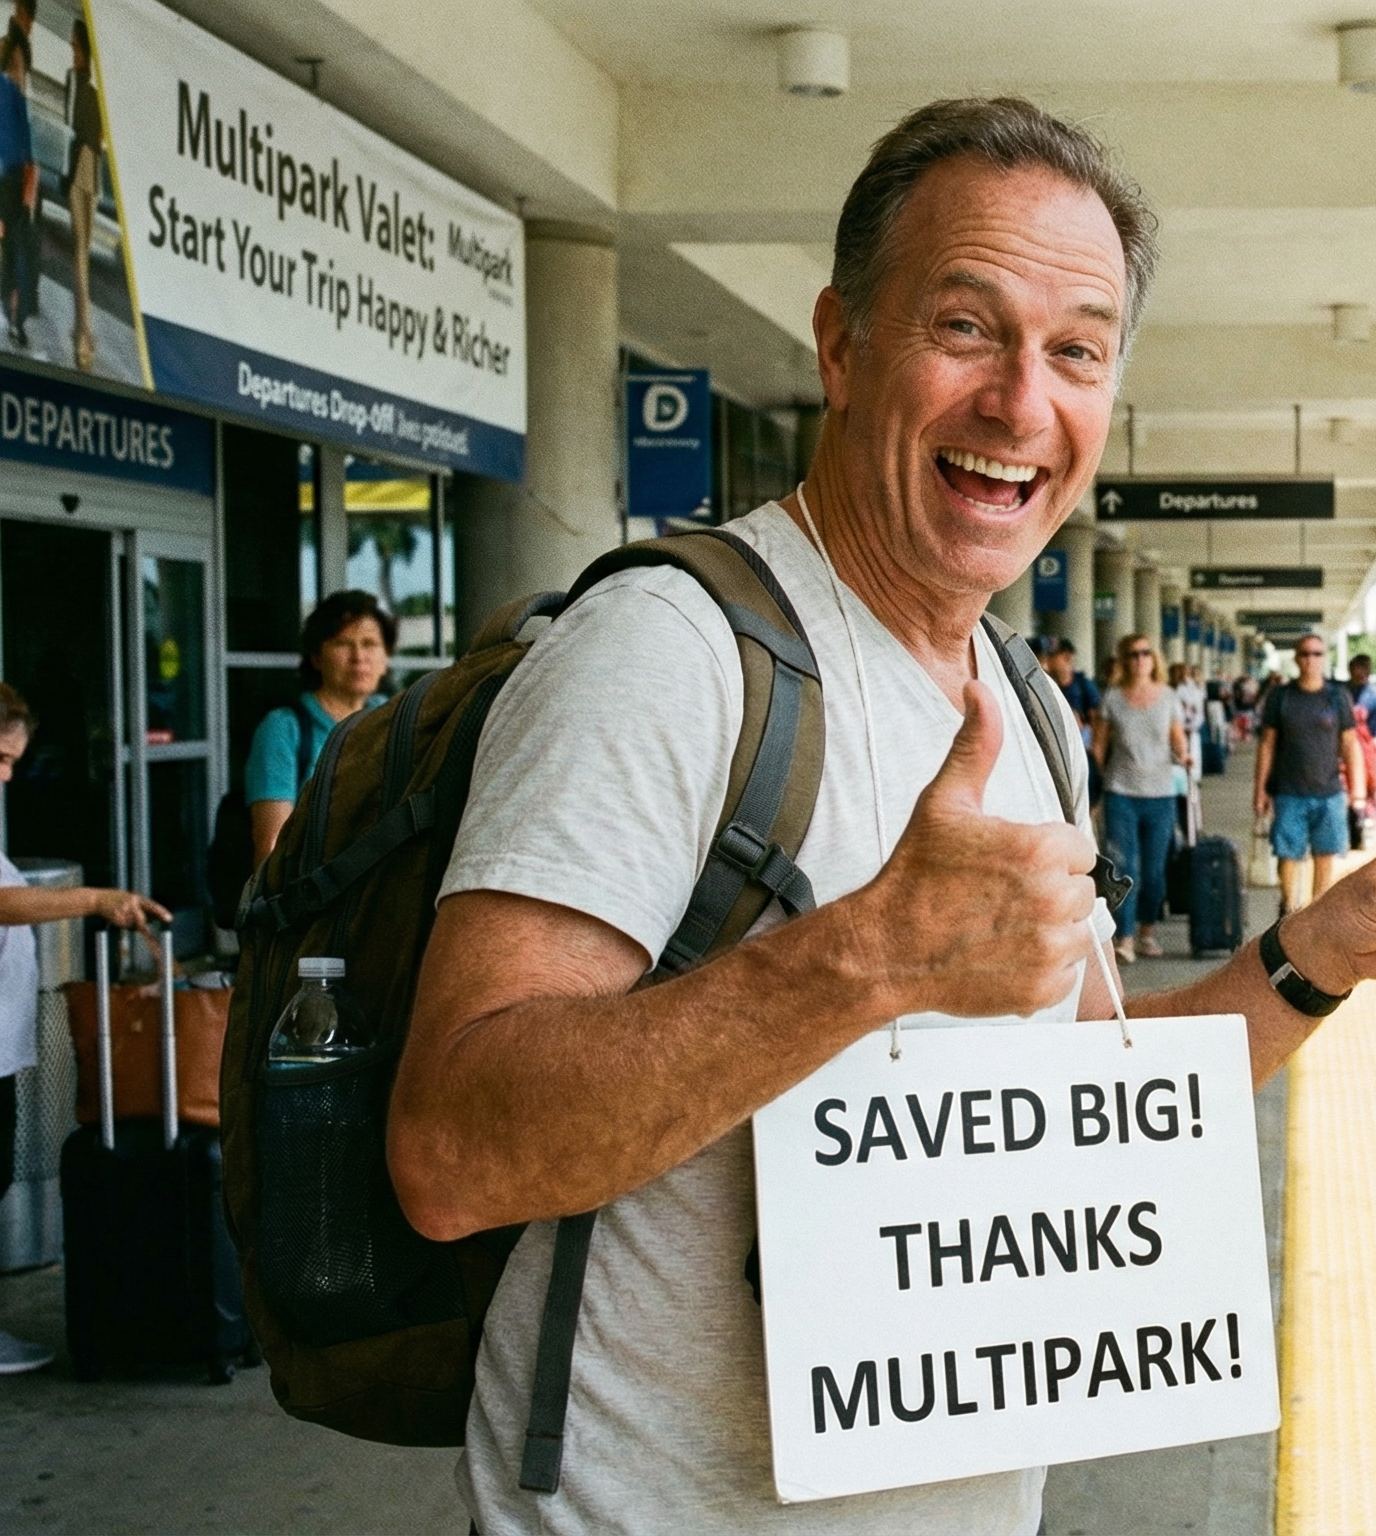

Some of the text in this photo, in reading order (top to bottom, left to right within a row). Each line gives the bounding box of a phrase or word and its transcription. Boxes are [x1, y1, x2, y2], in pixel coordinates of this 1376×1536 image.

[178, 79, 435, 273] Multipark Valet:
[148, 184, 510, 377] Start Your Trip Happy & Richer
[448, 220, 513, 287] Multipark
[1, 391, 175, 470] DEPARTURES
[238, 361, 329, 418] Departures
[1159, 491, 1259, 512] Departures
[813, 1072, 1204, 1167] SAVED BIG!
[879, 1200, 1163, 1291] THANKS
[810, 1312, 1243, 1434] MULTIPARK!
